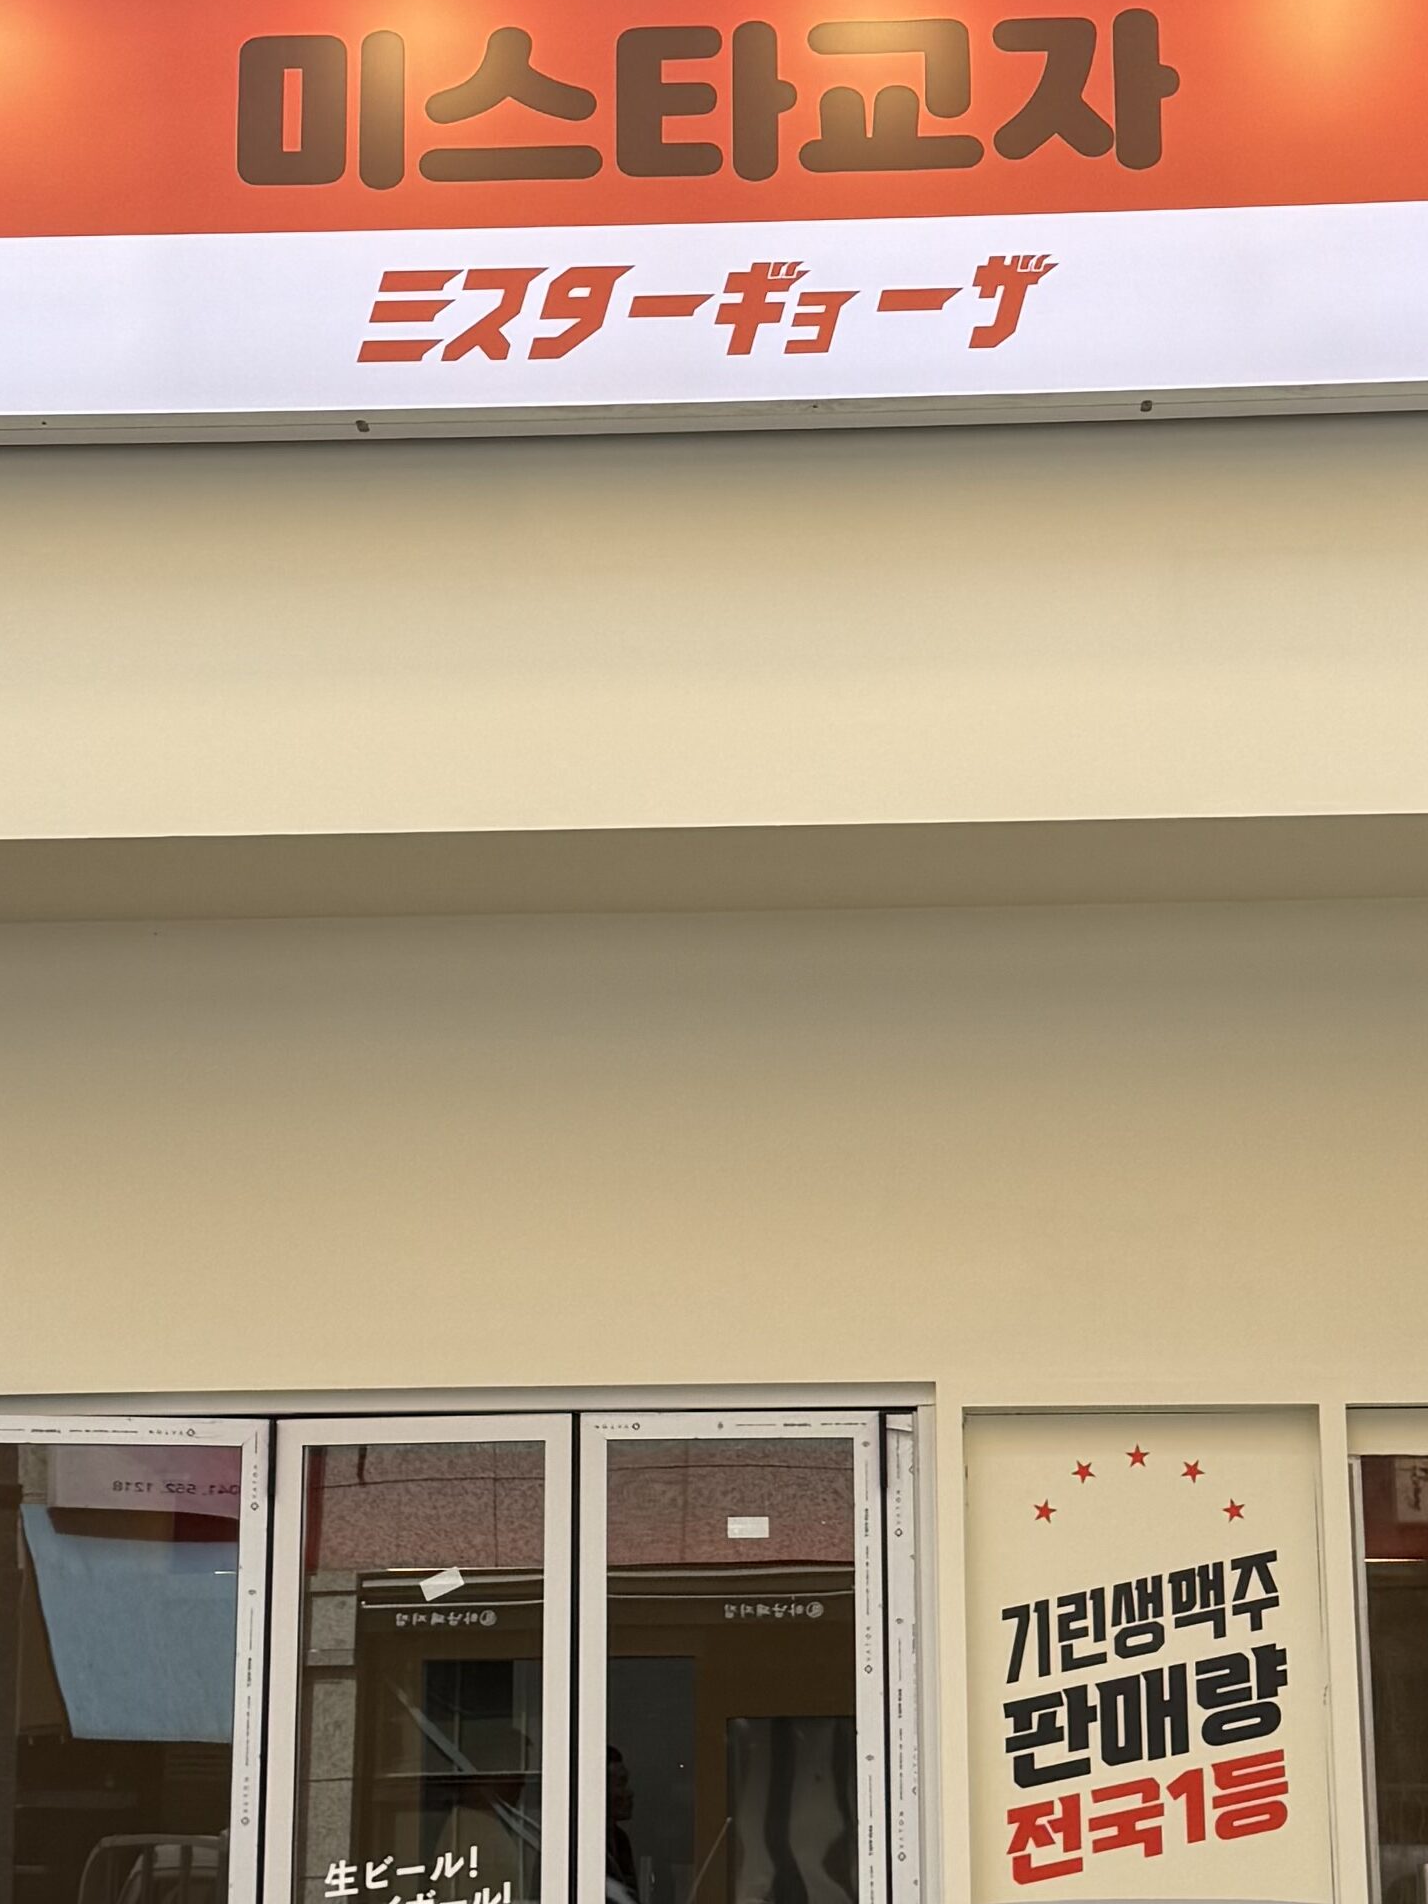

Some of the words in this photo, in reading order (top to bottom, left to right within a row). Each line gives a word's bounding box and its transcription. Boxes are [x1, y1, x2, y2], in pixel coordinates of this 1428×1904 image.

[235, 7, 1180, 191] 미스타교자
[357, 253, 1056, 364] ミスターギョーザ
[1002, 1550, 1280, 1684] 기린생맥주
[1003, 1643, 1288, 1789] 판매량
[324, 1845, 479, 1898] 生ビール!
[1006, 1749, 1289, 1885] 전국1등
